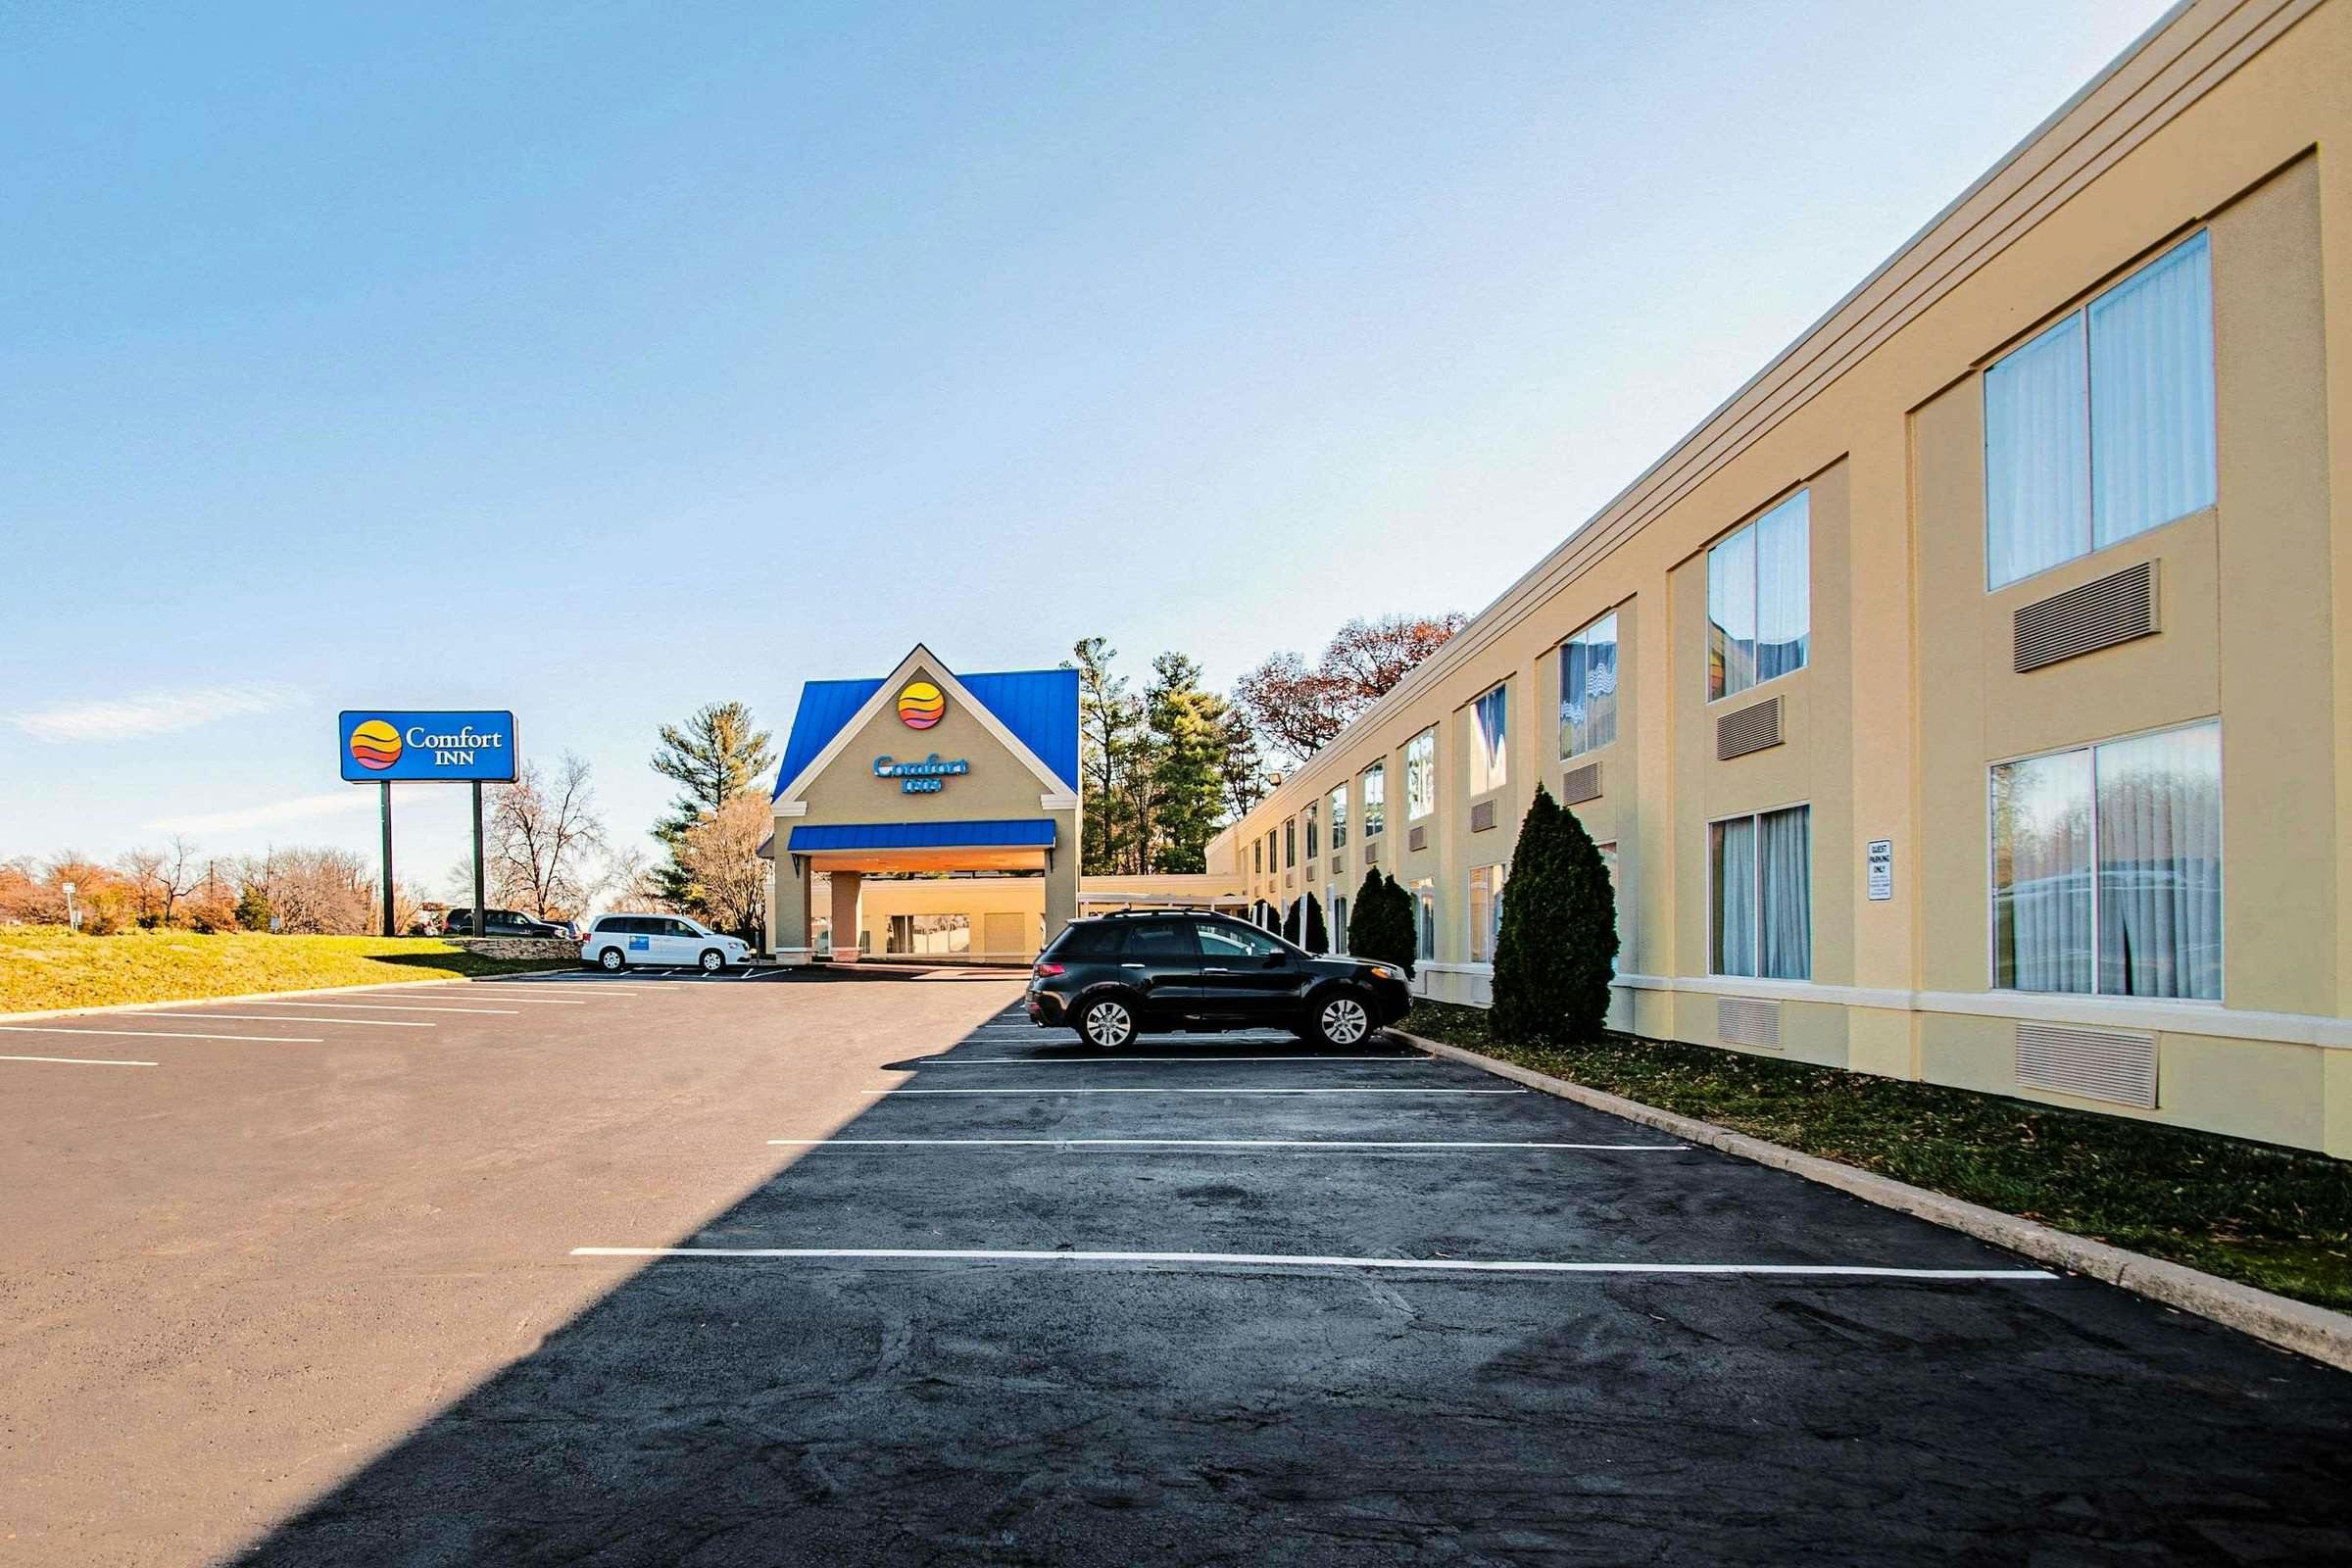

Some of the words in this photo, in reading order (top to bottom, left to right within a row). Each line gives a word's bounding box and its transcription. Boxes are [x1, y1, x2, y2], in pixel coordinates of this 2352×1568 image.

[406, 725, 503, 749] Comfort
[434, 751, 475, 765] INN
[1869, 855, 1890, 863] PARKING
